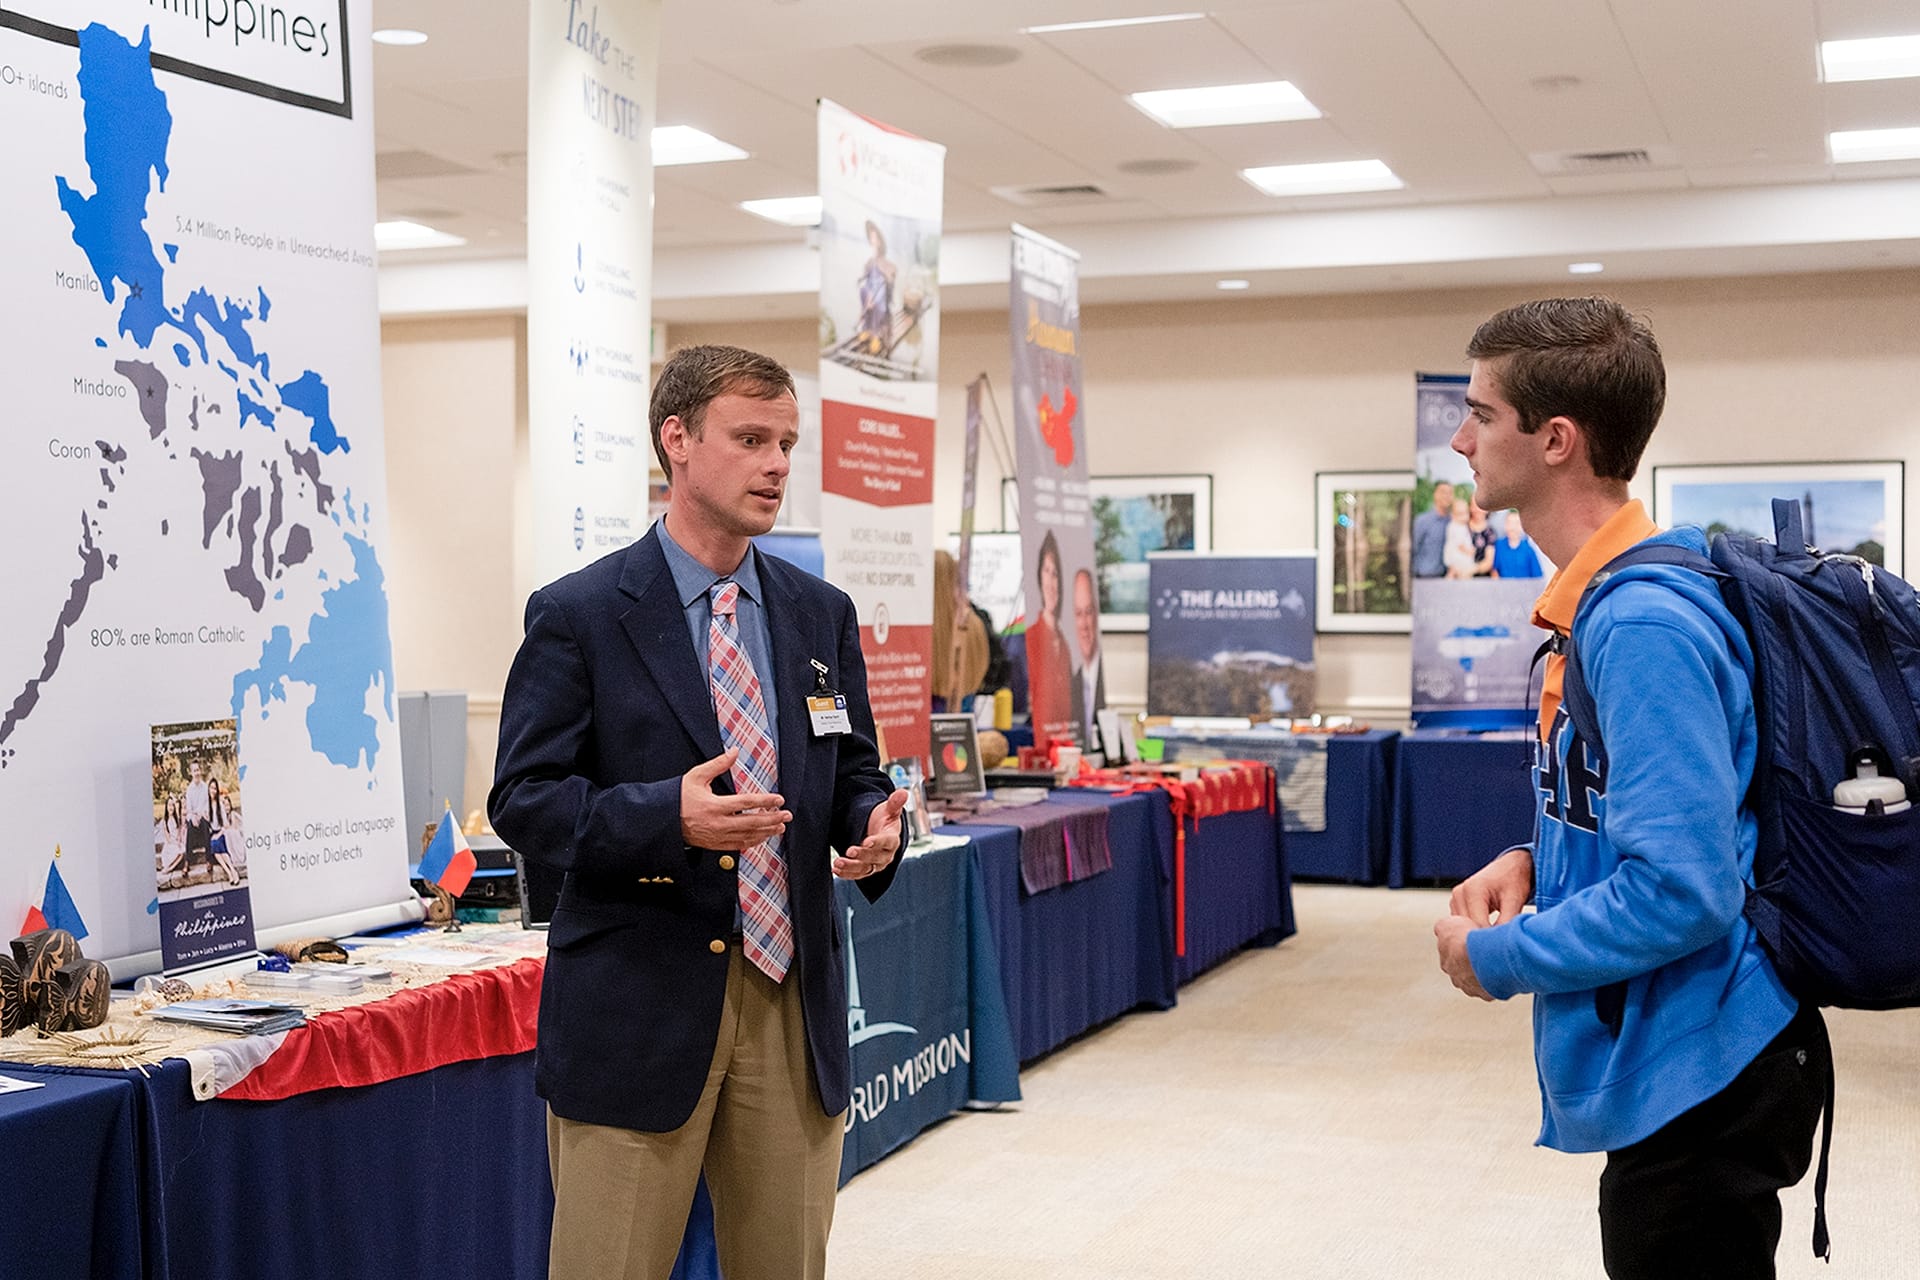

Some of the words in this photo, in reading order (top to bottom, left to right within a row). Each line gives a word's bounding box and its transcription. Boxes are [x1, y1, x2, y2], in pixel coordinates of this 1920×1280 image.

[564, 0, 611, 66] Take
[0, 65, 24, 85] 0+
[29, 73, 68, 99] islands
[583, 72, 610, 129] NEXT
[175, 215, 193, 234] 5.4
[196, 220, 231, 242] Million
[235, 226, 274, 251] People
[278, 235, 287, 252] in
[290, 237, 349, 263] Unreached
[55, 270, 99, 293] Manila
[73, 376, 127, 399] Mindoro
[1425, 404, 1470, 429] RO
[49, 438, 91, 460] Coron
[1180, 589, 1214, 608] THE
[1214, 589, 1280, 608] ALLENS
[90, 628, 126, 648] 80%
[130, 632, 151, 647] are
[155, 627, 195, 646] Roman
[199, 625, 246, 644] Catholic
[274, 830, 281, 845] is
[283, 827, 301, 843] the
[303, 819, 343, 841] Official
[345, 816, 396, 836] Language
[279, 853, 287, 871] 8
[290, 852, 320, 871] Major
[323, 845, 364, 864] Dialects
[173, 914, 247, 939] Philippines
[892, 1028, 971, 1102] MISSION
